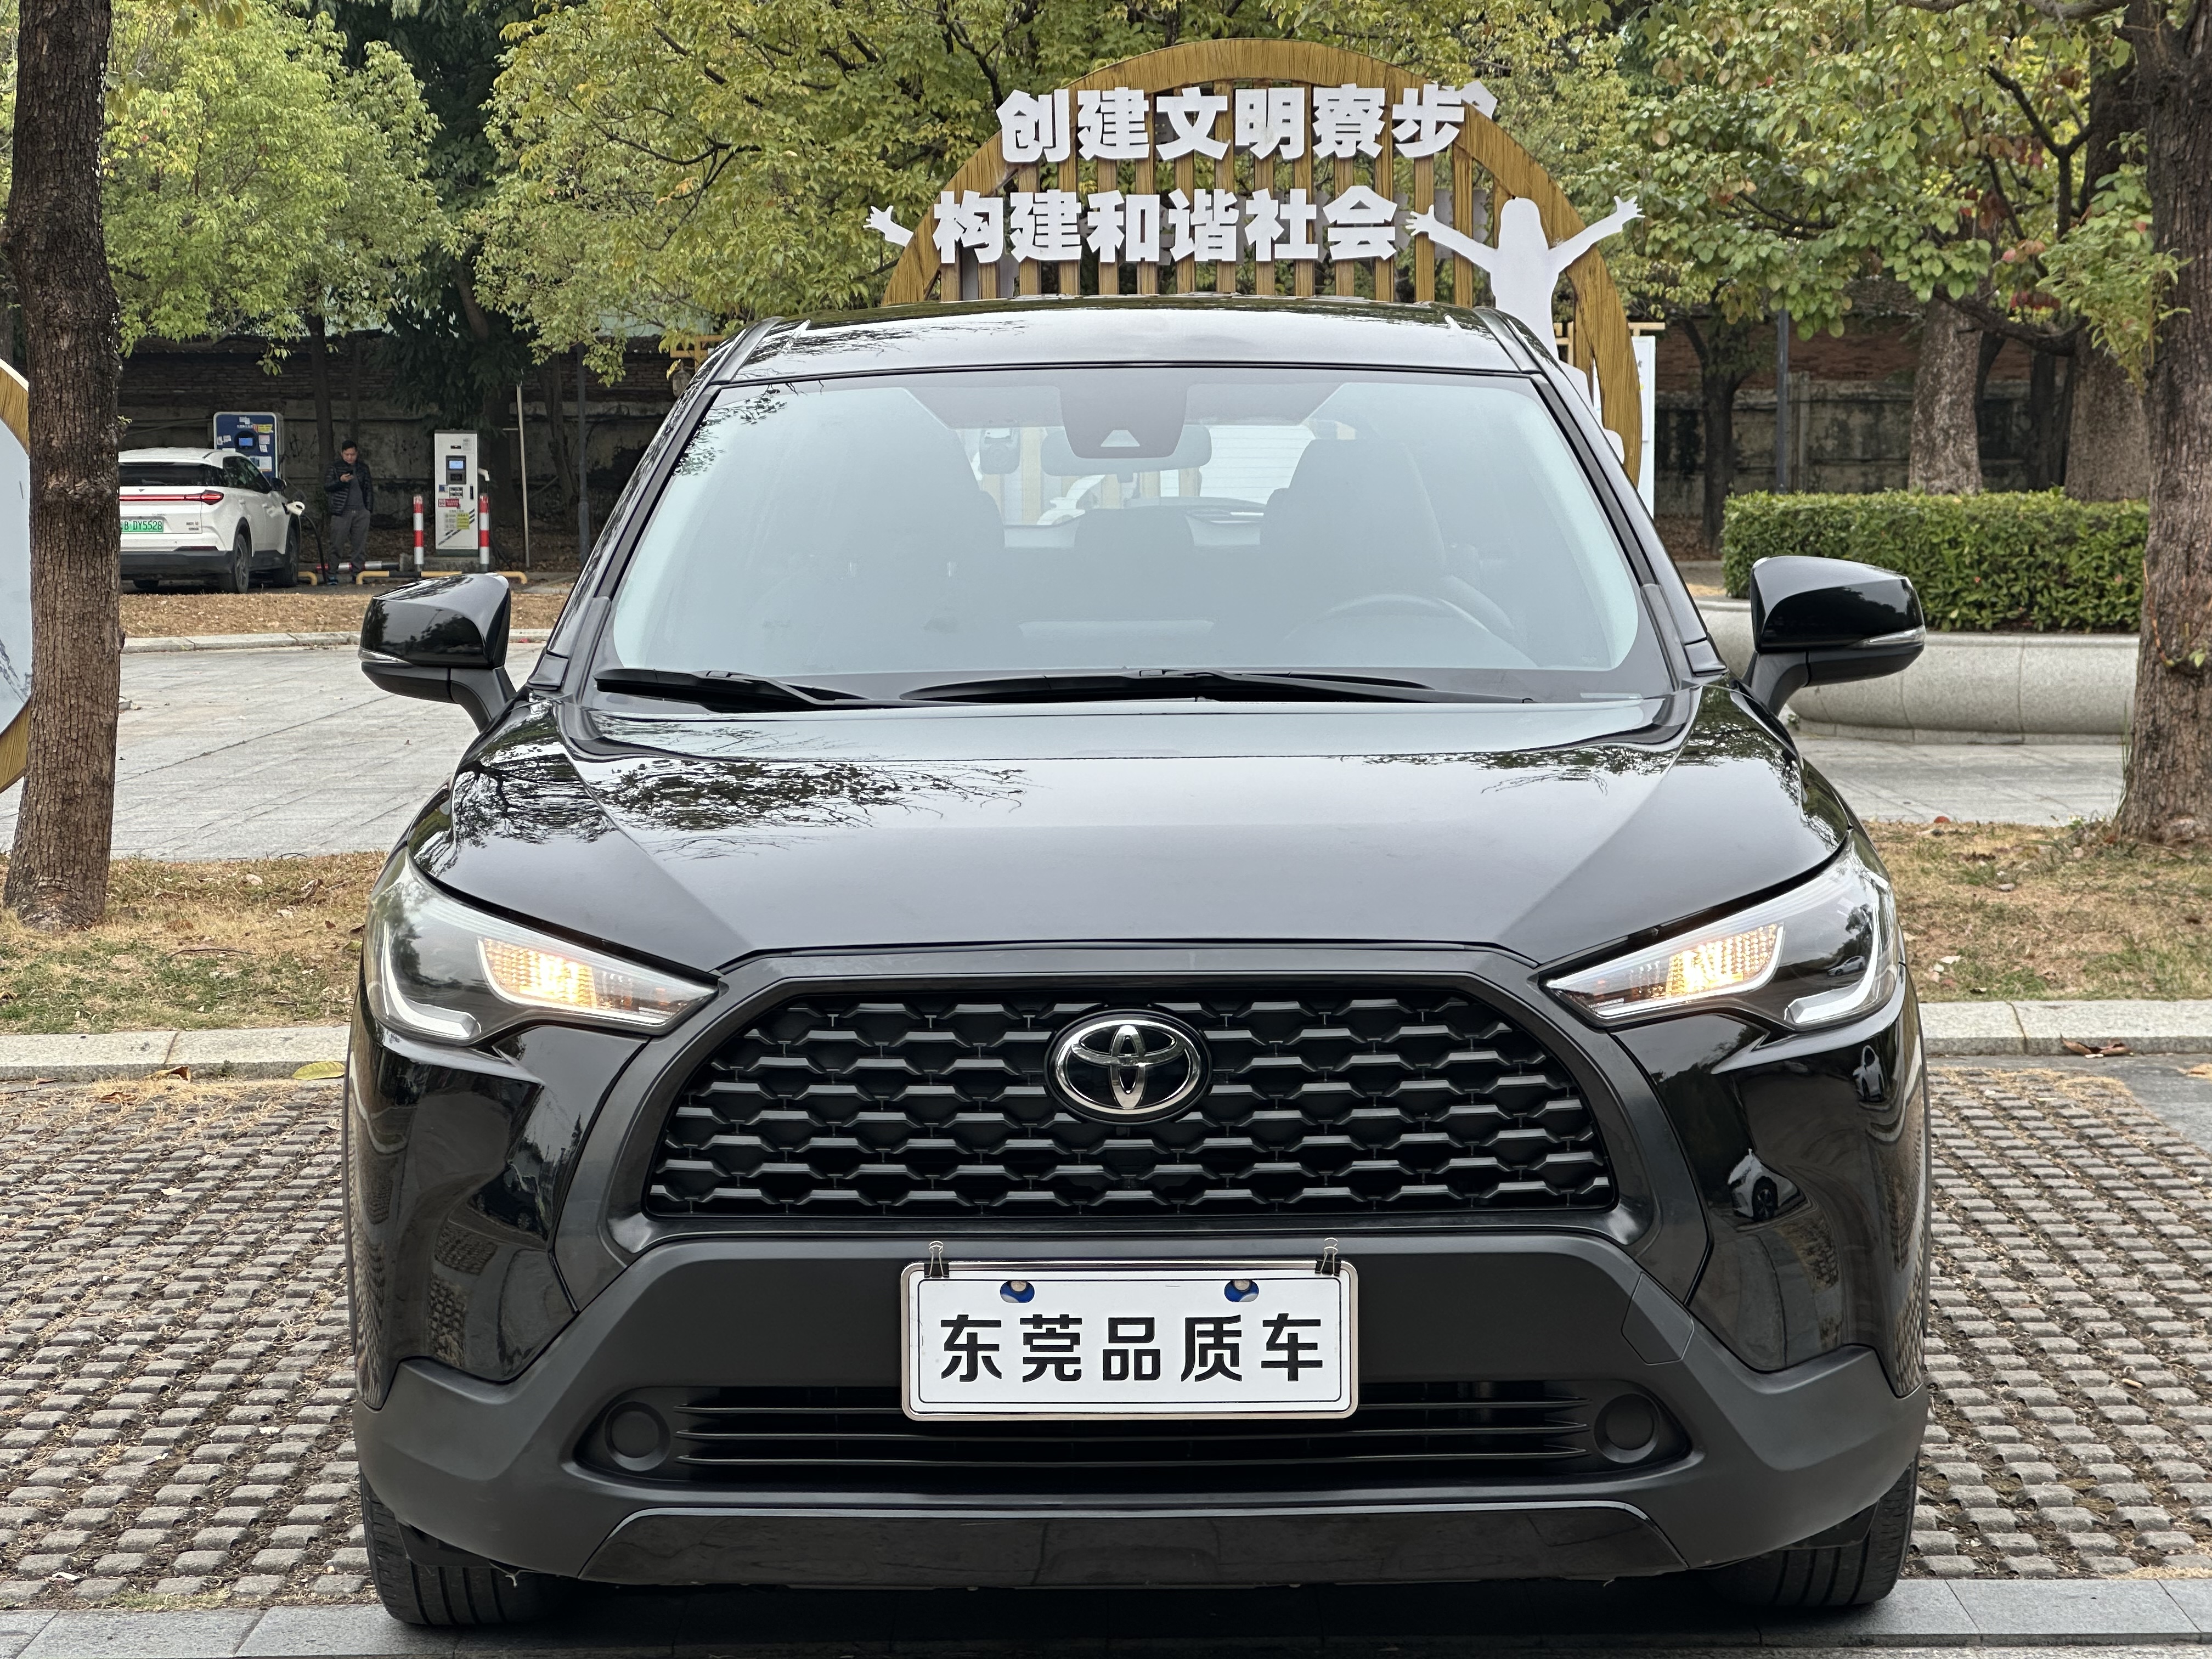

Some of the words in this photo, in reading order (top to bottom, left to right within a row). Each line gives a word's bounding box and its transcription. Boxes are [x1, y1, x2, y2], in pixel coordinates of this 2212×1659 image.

[996, 81, 1465, 162] 创建文明寮步
[932, 185, 1398, 263] 构建和谐社会
[133, 521, 162, 531] DY5528
[940, 1313, 1323, 1382] 东莞品质车
